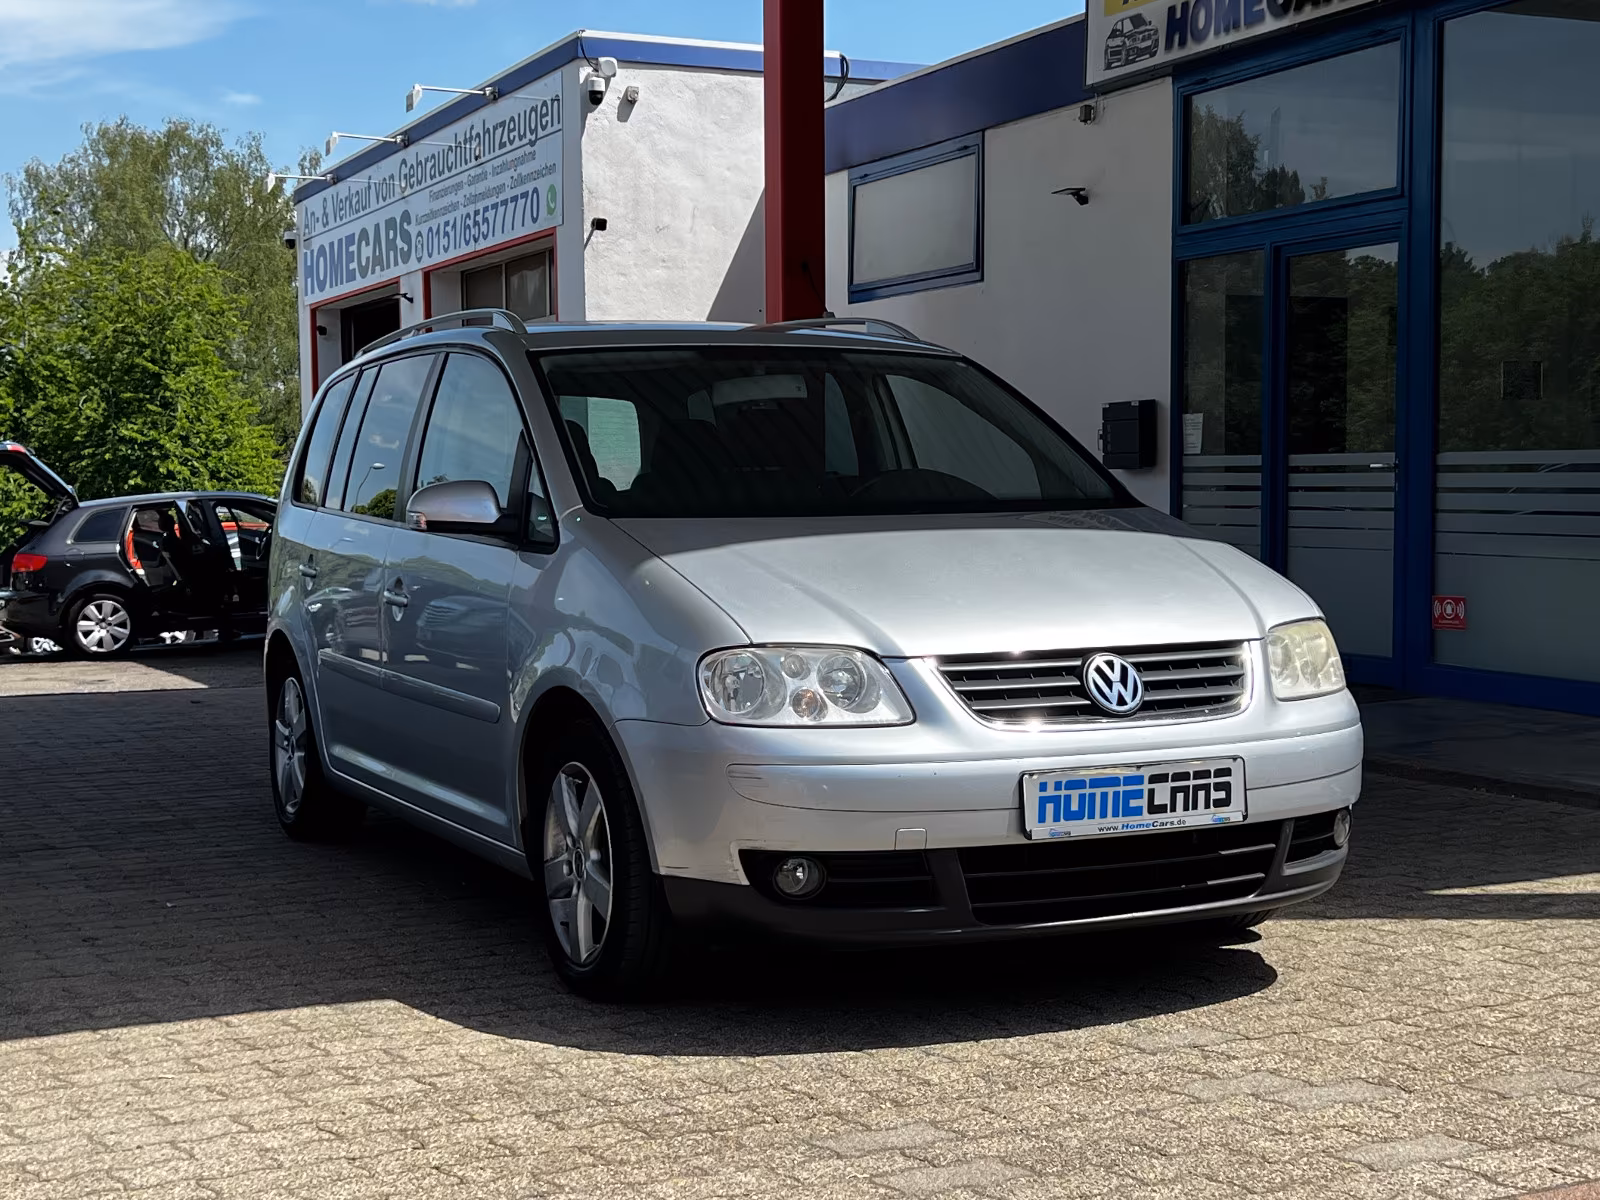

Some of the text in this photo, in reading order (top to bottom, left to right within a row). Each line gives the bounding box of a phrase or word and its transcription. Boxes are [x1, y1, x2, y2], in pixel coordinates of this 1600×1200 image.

[1164, 0, 1345, 51] HOME
[303, 94, 561, 236] An- & Verkauf von Gebrauchtfahrzeugen
[467, 168, 488, 187] Garantie
[510, 162, 557, 189] Zollkennzeichen
[304, 209, 413, 297] HOMECARS
[426, 186, 540, 259] 0151/65577770
